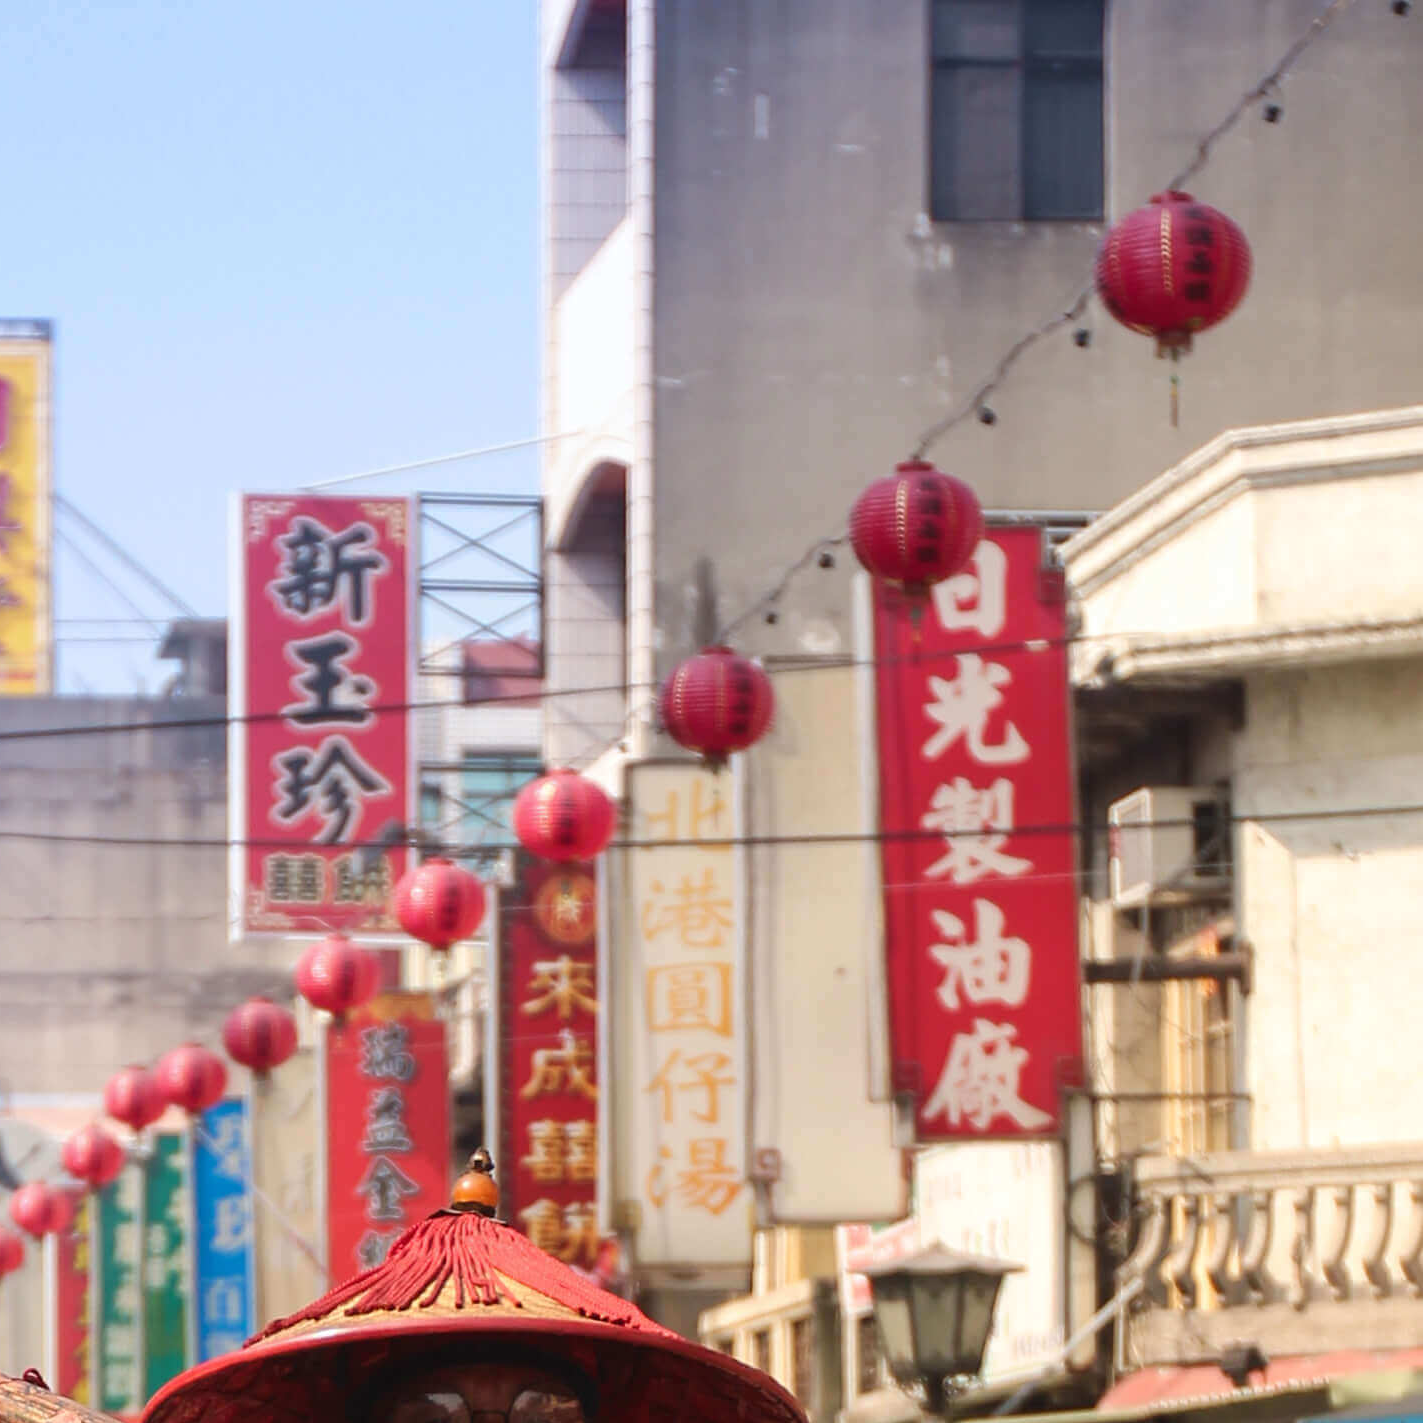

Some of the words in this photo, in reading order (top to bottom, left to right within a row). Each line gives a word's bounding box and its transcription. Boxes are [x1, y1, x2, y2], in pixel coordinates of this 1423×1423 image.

[267, 514, 393, 844] 新玉珍
[919, 540, 1054, 1131] 日光製油廠
[641, 778, 741, 1218] 北港圓仔湯
